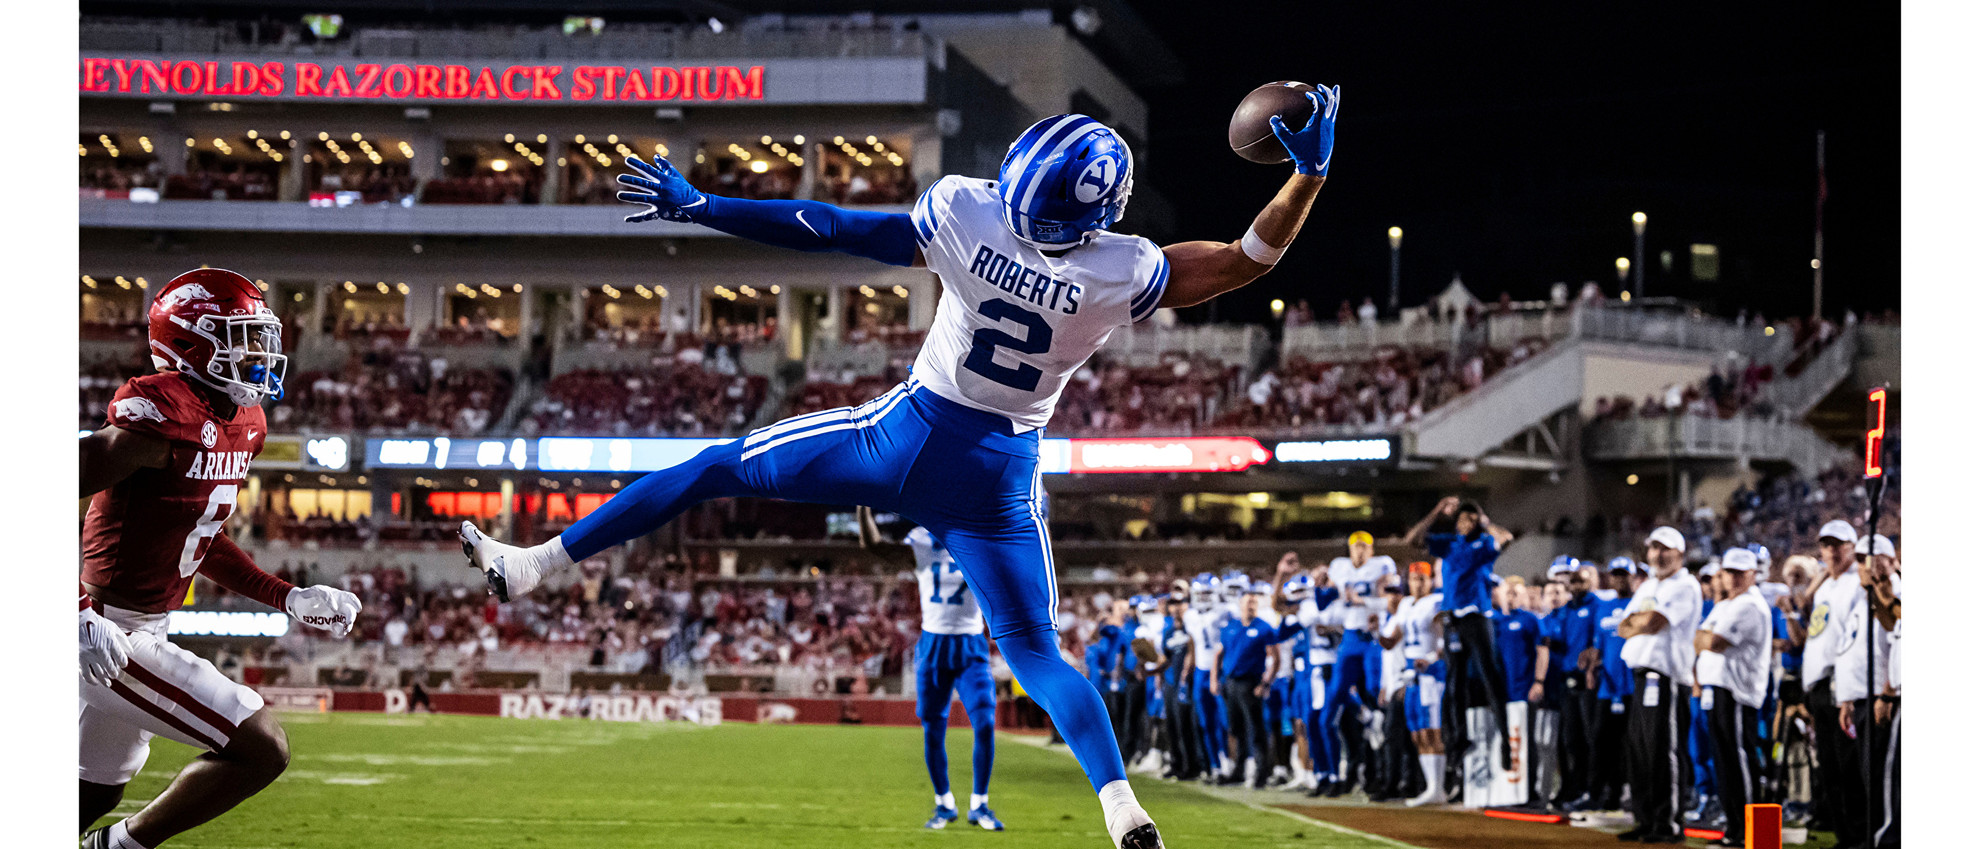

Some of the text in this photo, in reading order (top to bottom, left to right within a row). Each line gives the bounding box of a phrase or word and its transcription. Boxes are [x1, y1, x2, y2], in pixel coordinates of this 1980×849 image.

[295, 62, 563, 100] RAZORBACK
[571, 65, 764, 101] STADIUM
[1080, 159, 1109, 197] Y
[969, 244, 1082, 315] ROBERTS
[962, 297, 1053, 392] 2
[1866, 389, 1886, 478] 2
[930, 561, 968, 605] 17
